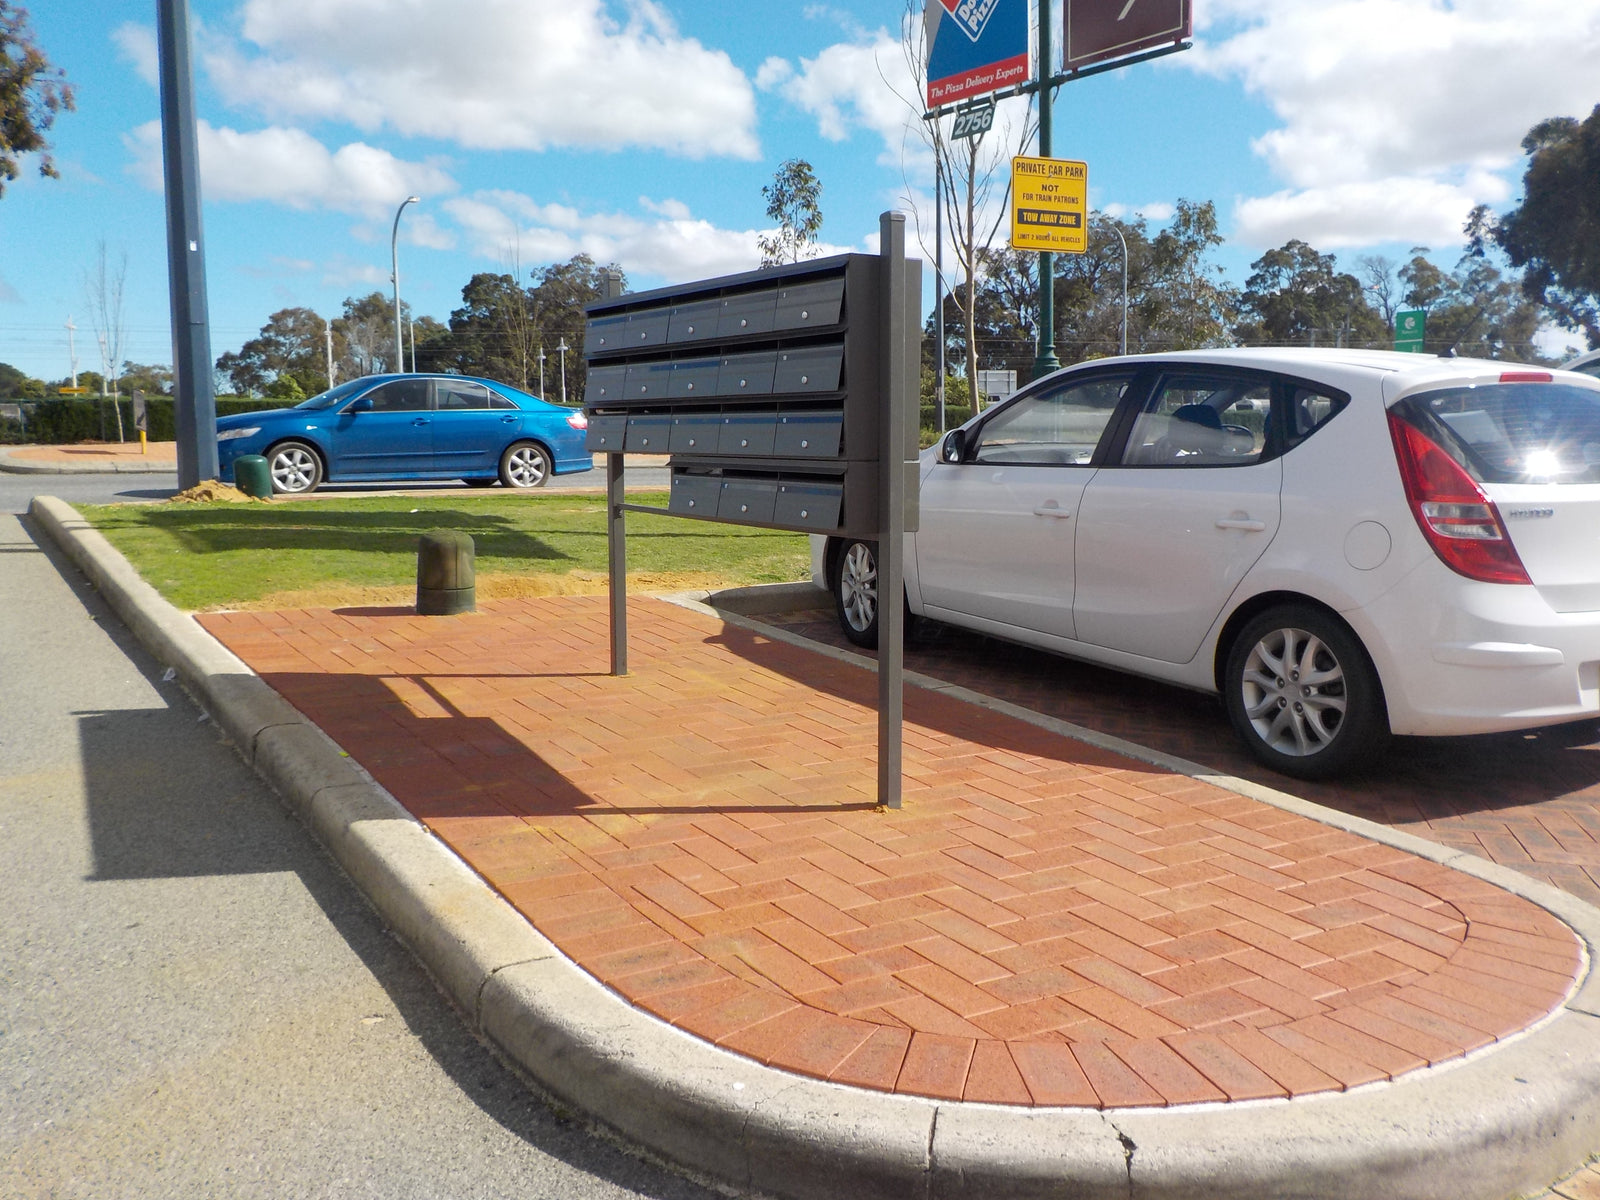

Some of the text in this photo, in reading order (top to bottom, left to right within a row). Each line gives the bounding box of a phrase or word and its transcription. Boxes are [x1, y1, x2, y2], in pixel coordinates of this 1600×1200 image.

[931, 65, 1023, 98] The Pizza Delivery Experts
[955, 108, 993, 135] 2756
[1016, 162, 1084, 178] PRIVATE CAR PARK
[1041, 184, 1060, 193] NOT
[1022, 192, 1079, 204] FOR TRAIN PATRONS
[1023, 212, 1076, 225] TOW AWAY ZONE
